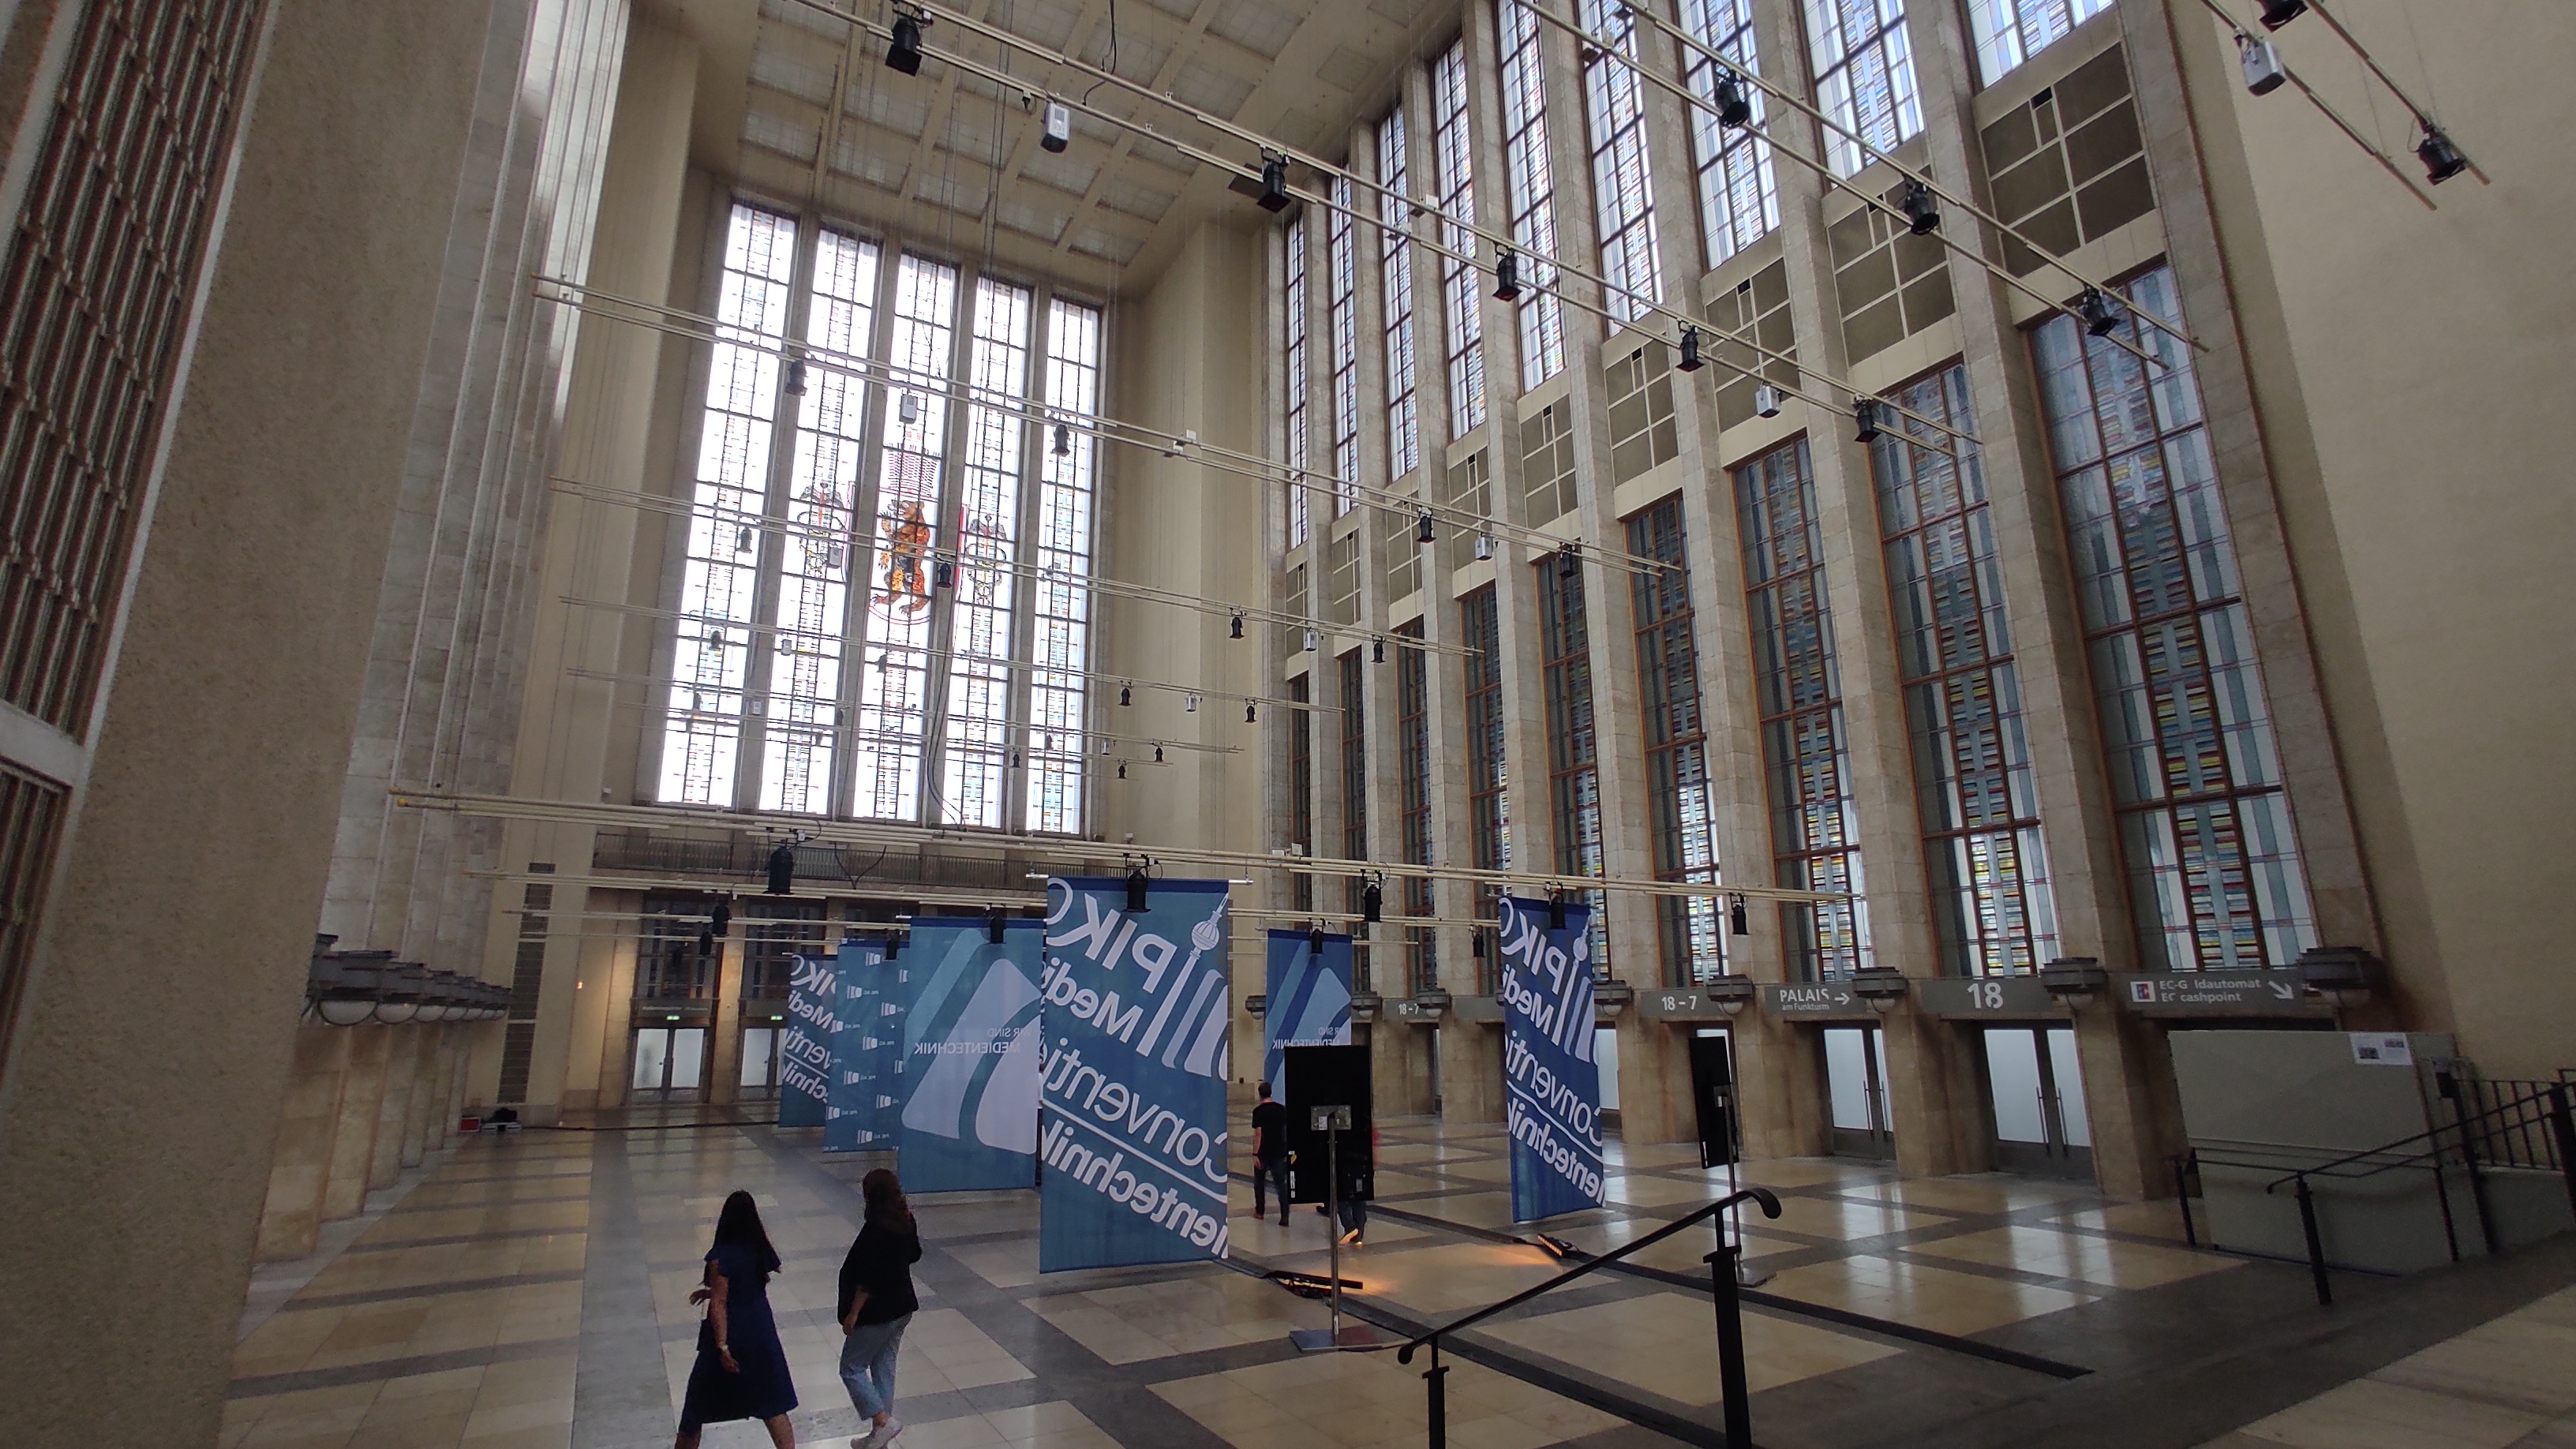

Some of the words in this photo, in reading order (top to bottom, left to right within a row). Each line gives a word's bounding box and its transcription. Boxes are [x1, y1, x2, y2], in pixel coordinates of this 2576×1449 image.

[1780, 988, 1829, 1002] PALAIS
[1967, 983, 2003, 1009] 18
[2181, 992, 2241, 1003] cashpoint
